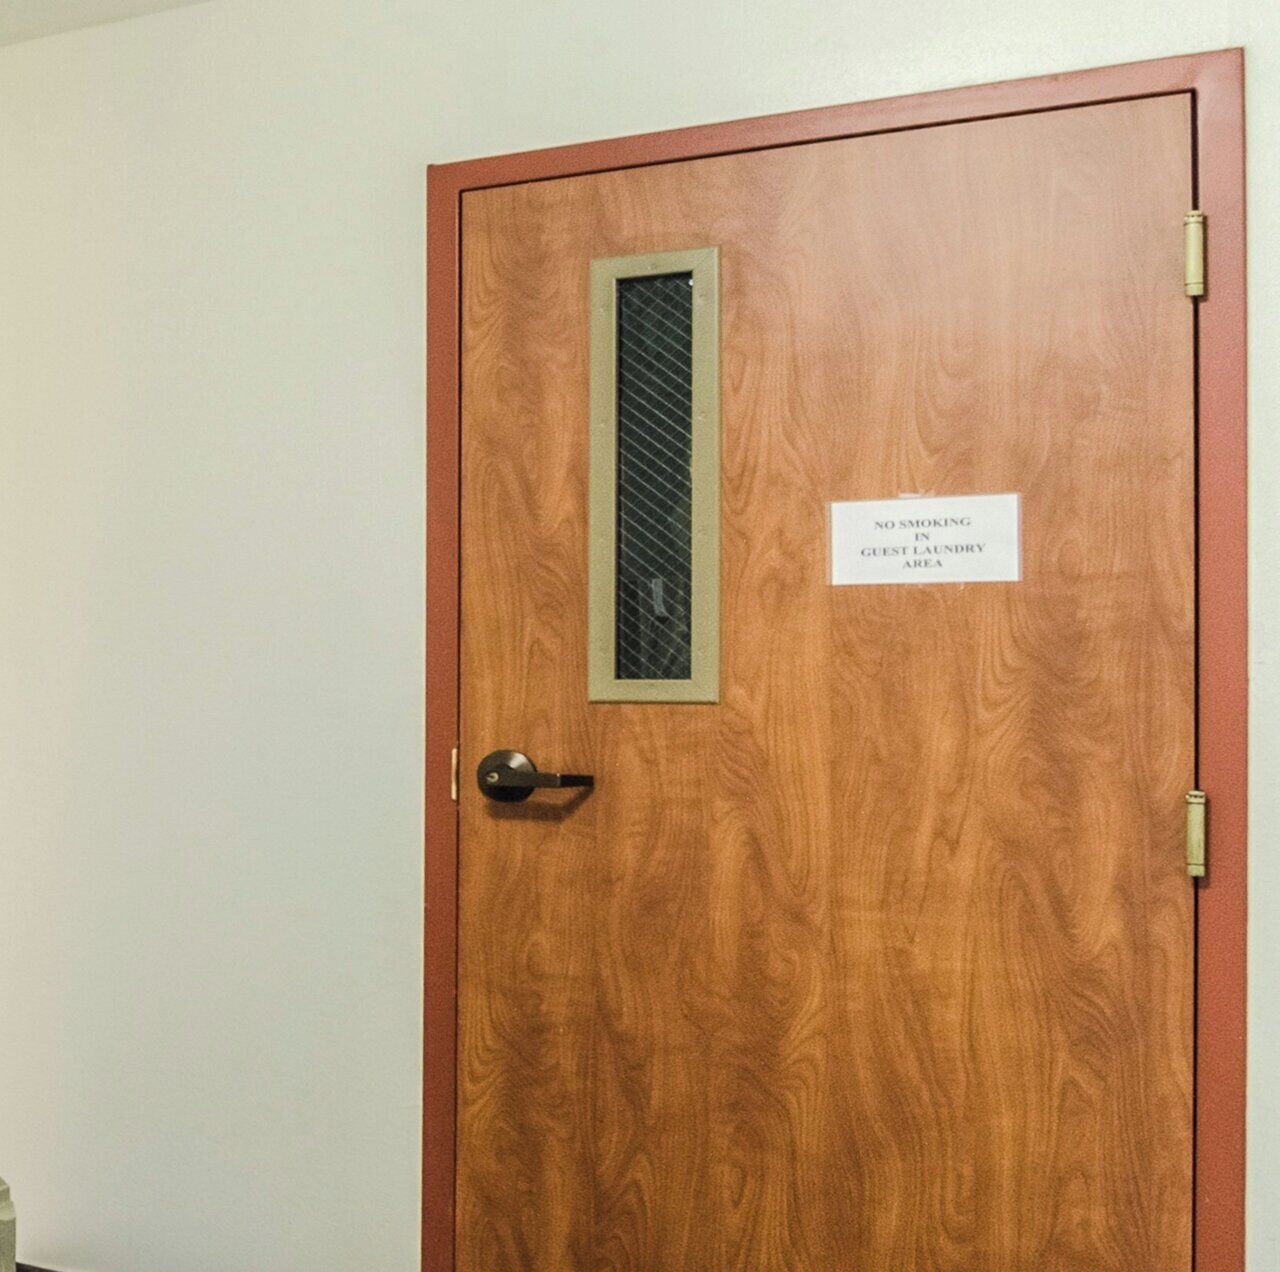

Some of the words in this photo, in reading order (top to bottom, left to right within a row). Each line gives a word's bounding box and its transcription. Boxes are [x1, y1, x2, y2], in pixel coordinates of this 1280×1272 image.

[874, 520, 895, 530] NO
[899, 517, 971, 530] SMOKING
[914, 532, 930, 541] IN
[860, 546, 908, 558] GUEST
[913, 543, 986, 555] LAUNDRY
[902, 559, 943, 569] AREA
